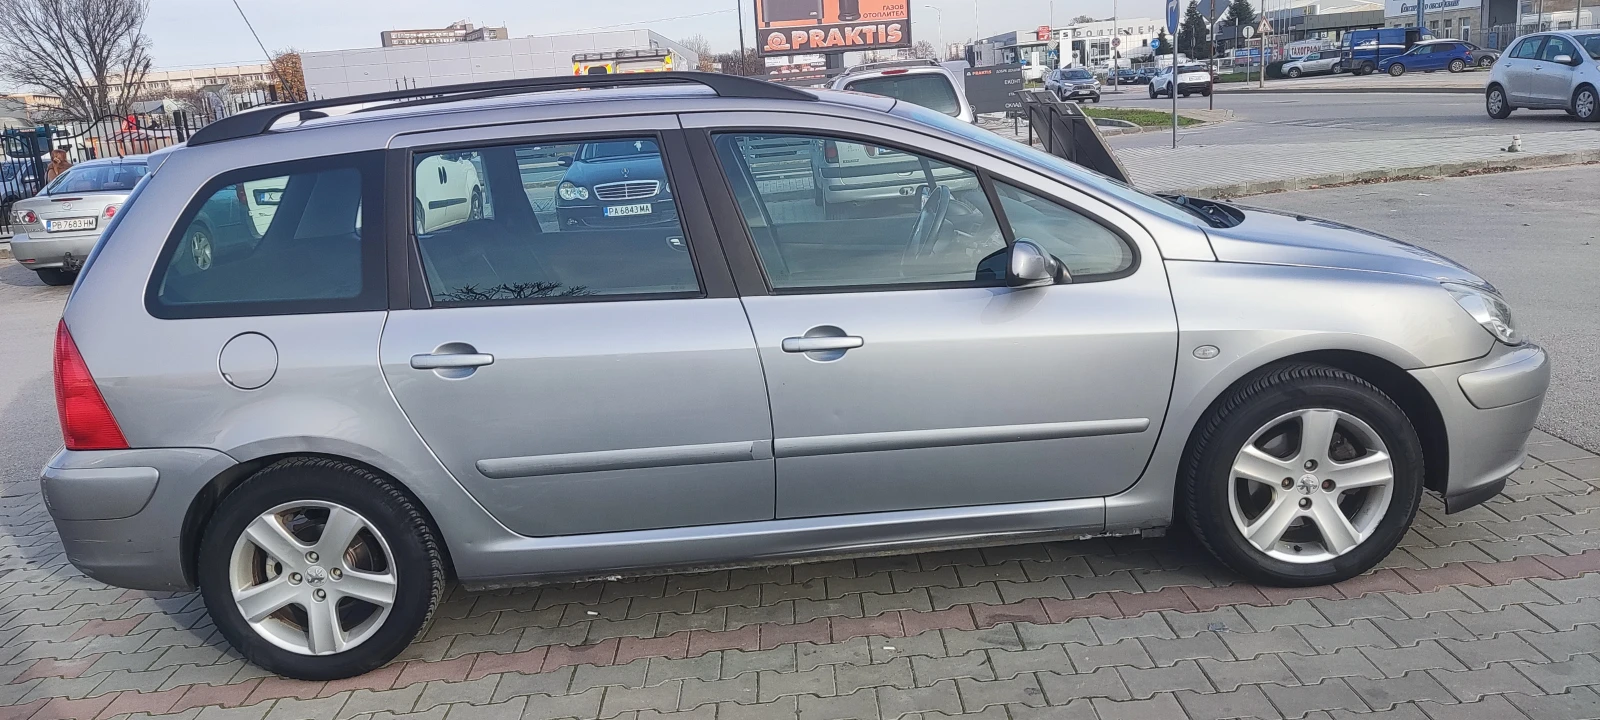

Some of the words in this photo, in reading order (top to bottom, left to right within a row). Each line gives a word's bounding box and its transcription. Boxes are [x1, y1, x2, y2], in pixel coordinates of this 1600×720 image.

[862, 10, 905, 19] ОТОПЛИТЕЛ
[791, 24, 902, 49] PRAKTIS
[608, 207, 619, 215] PA
[620, 206, 638, 214] 6843
[52, 221, 62, 230] PB
[64, 220, 82, 228] 7683
